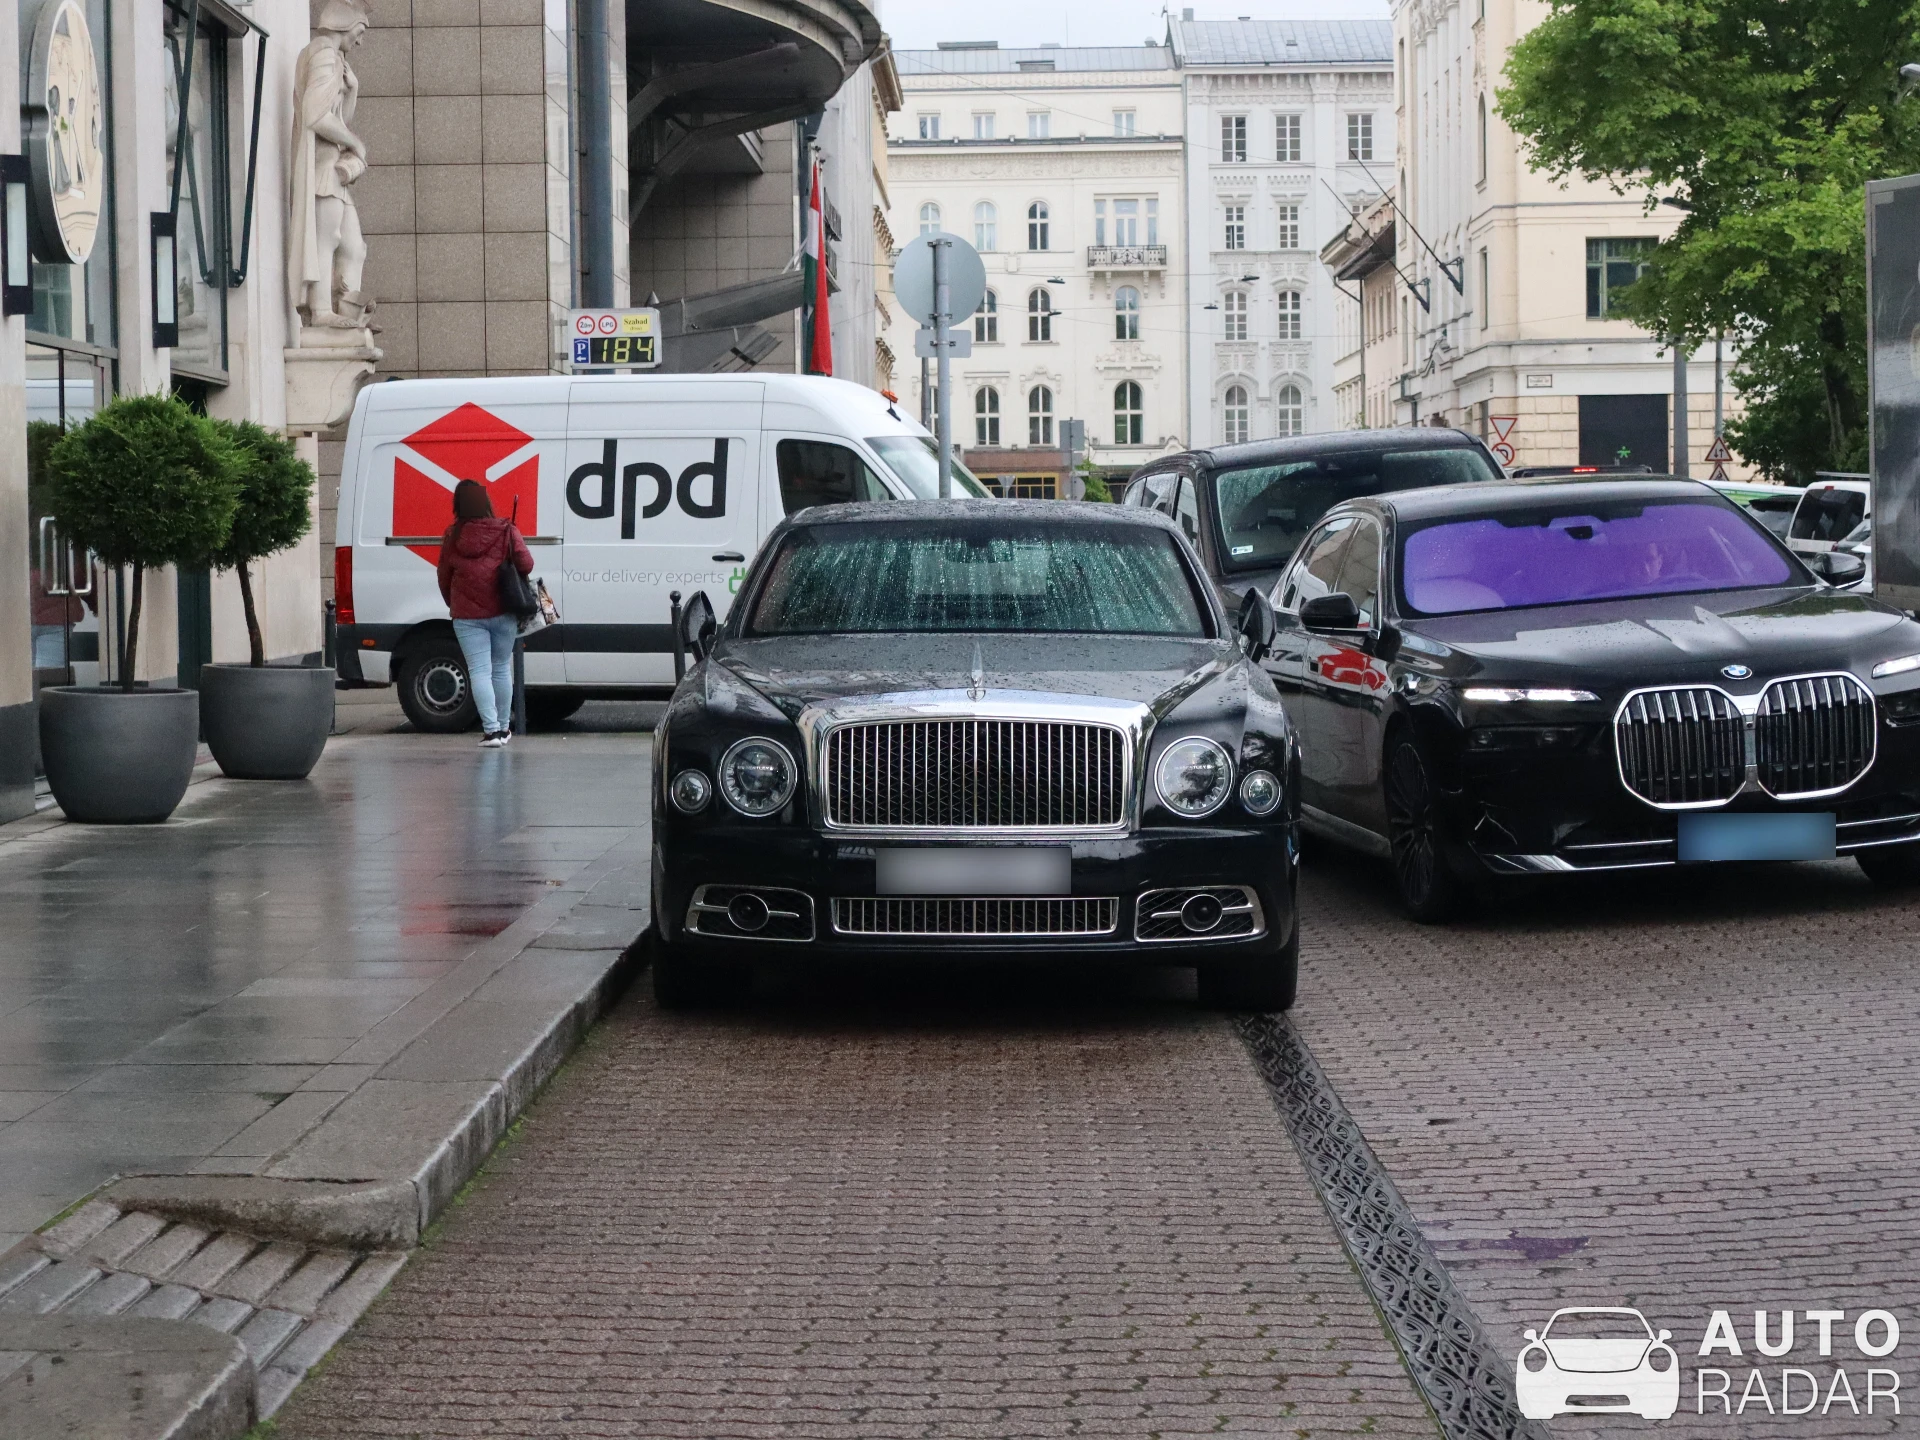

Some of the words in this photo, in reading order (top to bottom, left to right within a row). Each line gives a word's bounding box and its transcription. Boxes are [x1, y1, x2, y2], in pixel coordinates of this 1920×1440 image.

[577, 343, 586, 354] P
[603, 337, 653, 362] 184
[566, 438, 729, 540] dpd
[564, 570, 599, 583] Your
[602, 569, 662, 586] delivery
[665, 570, 725, 586] experts
